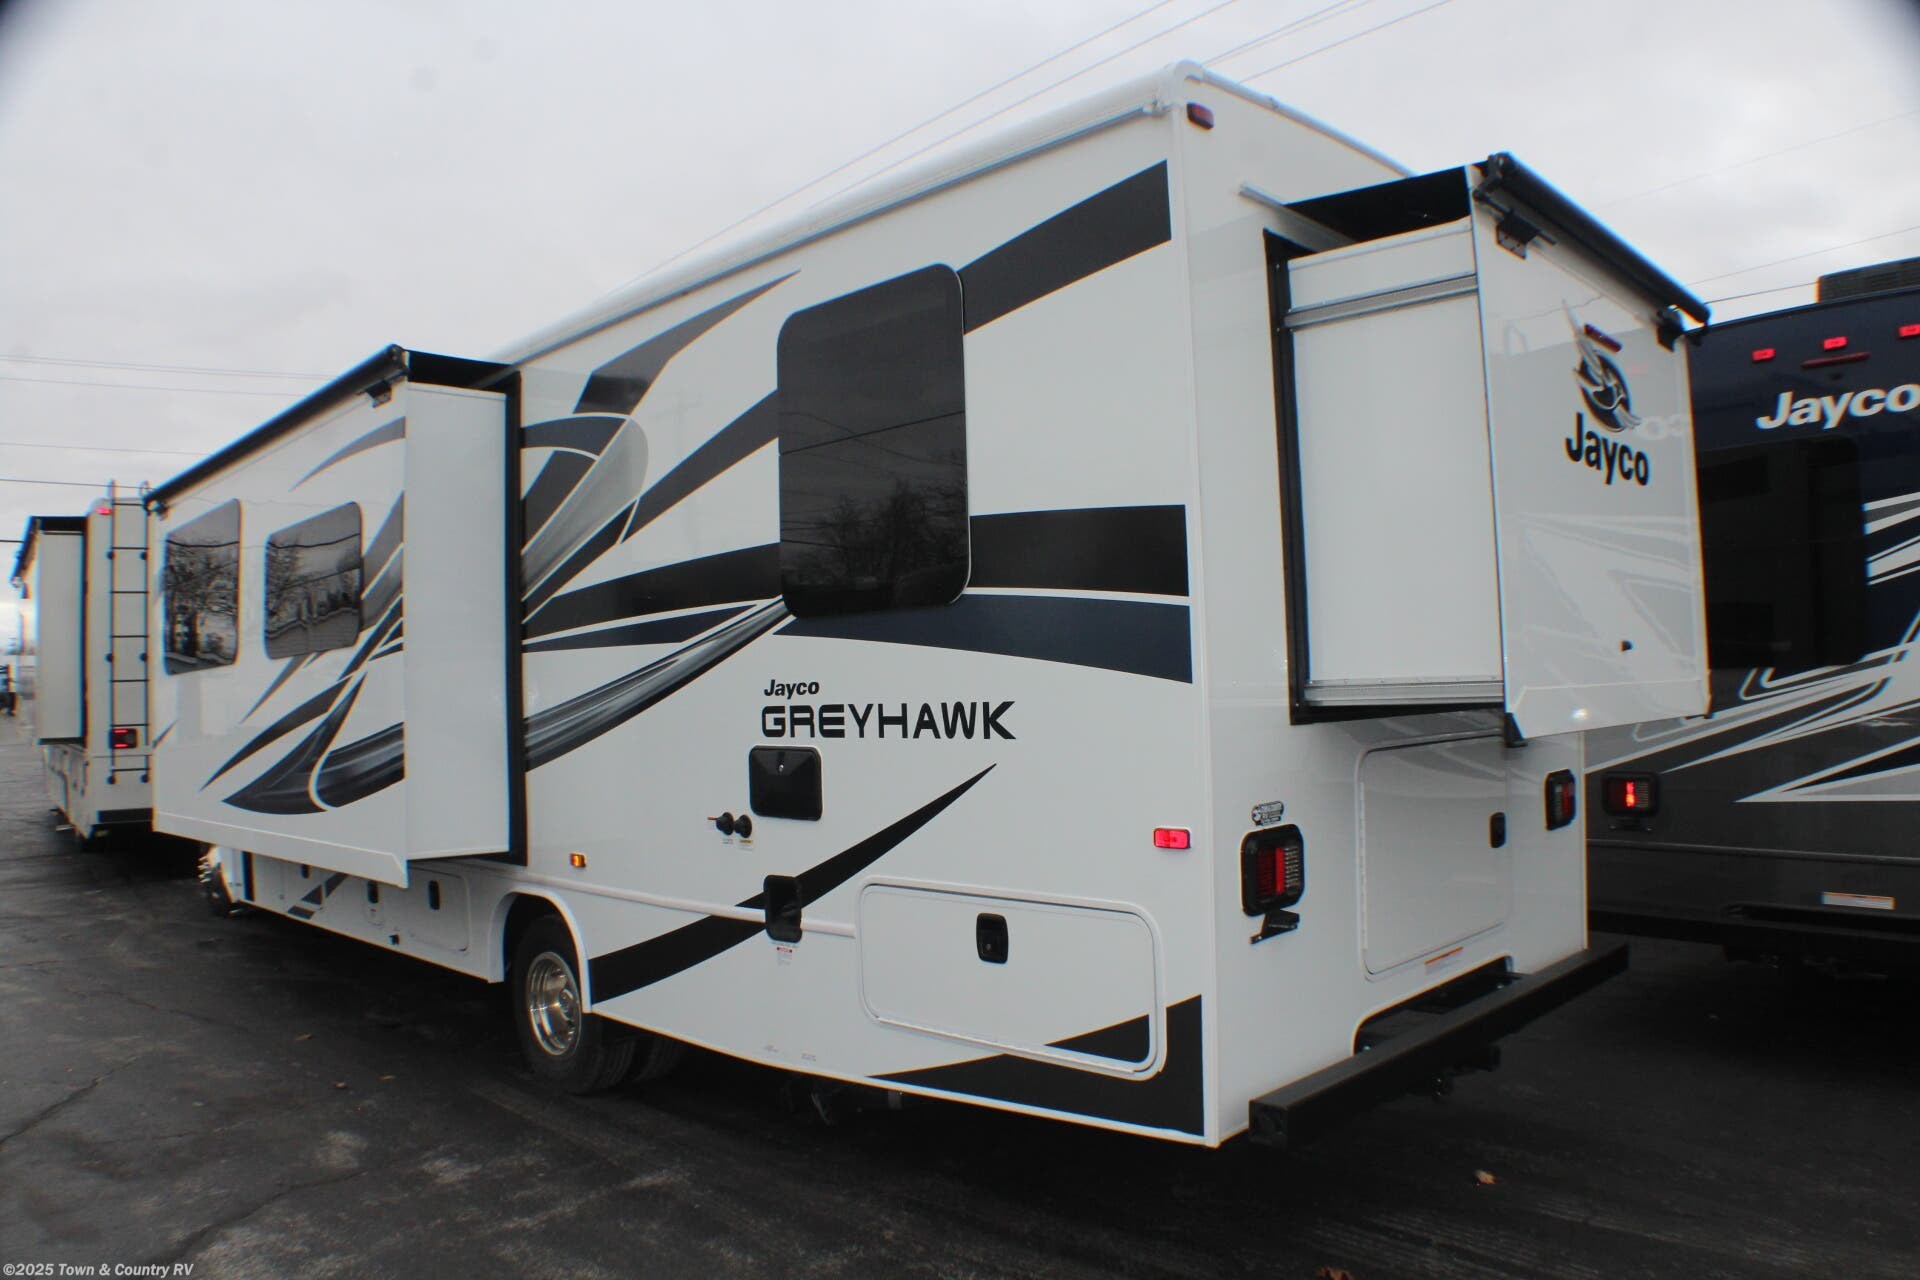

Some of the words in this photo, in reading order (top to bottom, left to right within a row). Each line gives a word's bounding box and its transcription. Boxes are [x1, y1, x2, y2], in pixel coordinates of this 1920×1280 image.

[1756, 383, 1920, 430] Jayco
[1565, 412, 1650, 487] Jayco
[763, 679, 820, 700] Jayco
[761, 701, 1017, 740] GREYHAWK
